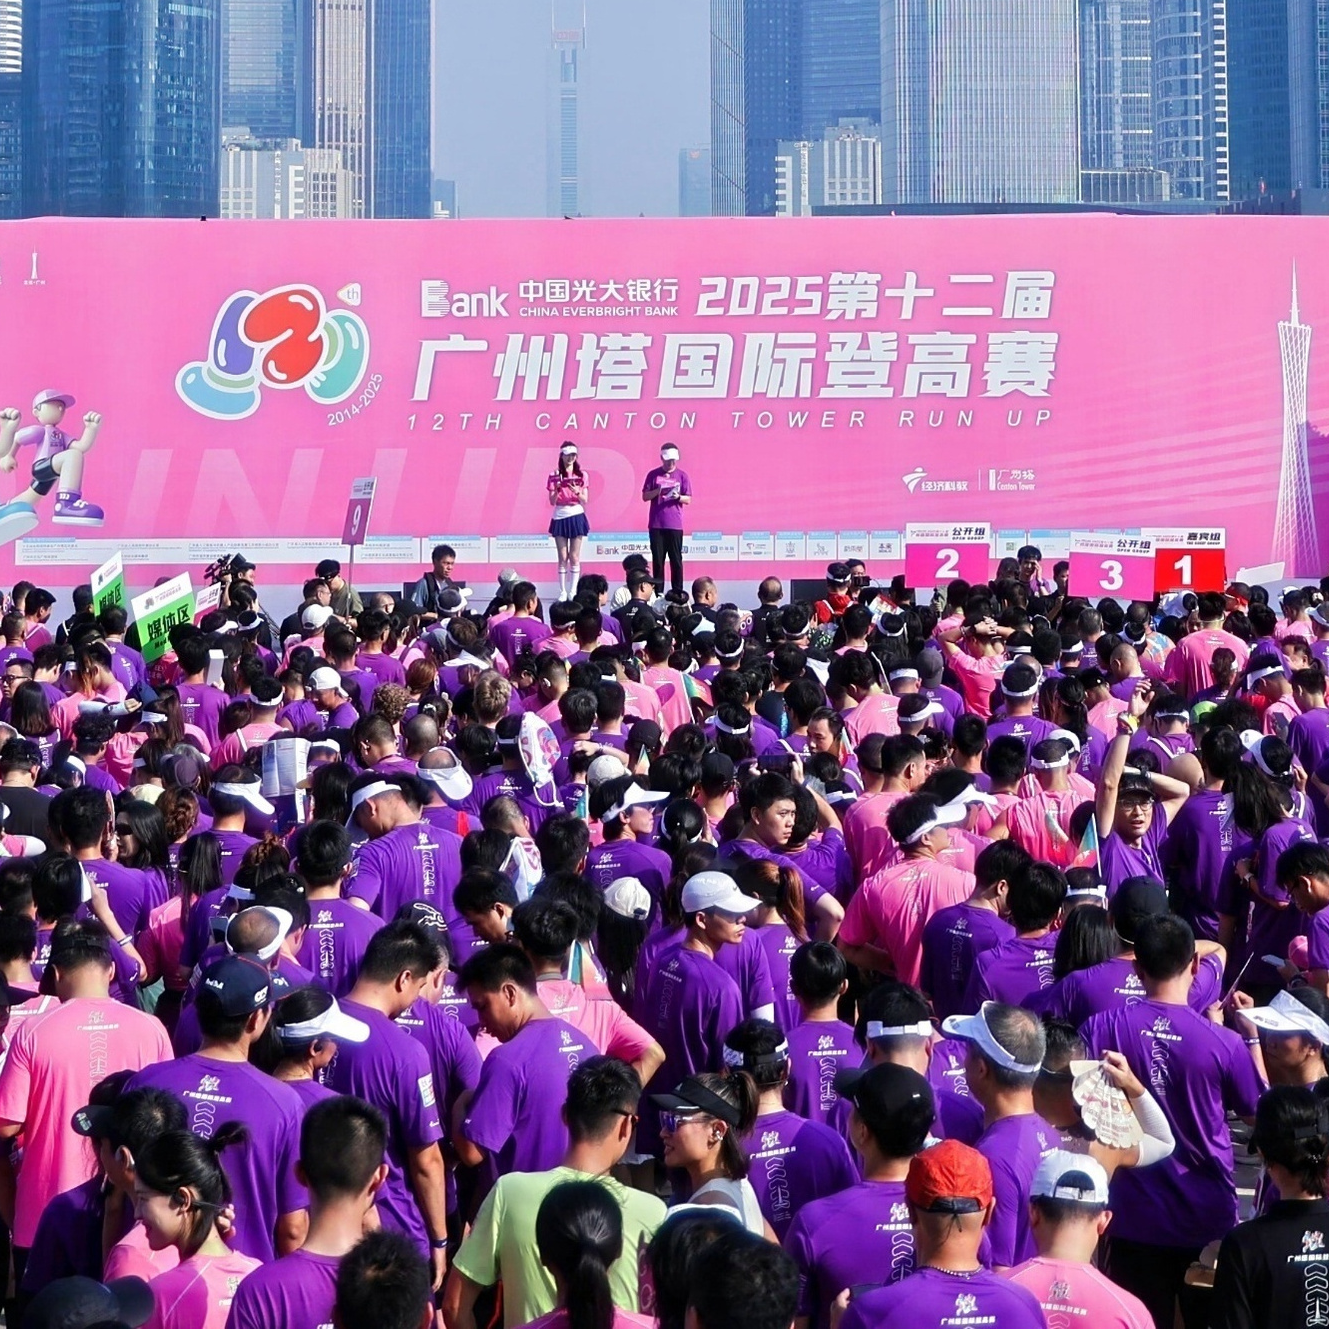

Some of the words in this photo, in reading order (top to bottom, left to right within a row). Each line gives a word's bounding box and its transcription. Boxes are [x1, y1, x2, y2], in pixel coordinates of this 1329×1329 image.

[421, 280, 510, 318] Bank
[519, 278, 679, 303] 中国光大银行
[694, 271, 1056, 321] 2025第十二届
[519, 306, 559, 318] CHINA
[562, 306, 642, 318] EVERBRIGHT
[645, 306, 679, 317] BANK
[409, 330, 1059, 402] 广州塔国际登高赛
[326, 372, 384, 427] 2014-2025
[407, 412, 502, 431] 12TH
[535, 411, 697, 430] CANTON
[731, 411, 867, 429] TOWER
[898, 410, 974, 428] RUN
[1006, 410, 1052, 427] UP
[351, 504, 362, 536] 9
[935, 548, 960, 579] 2
[1099, 559, 1124, 591] 3
[1174, 555, 1191, 585] 1
